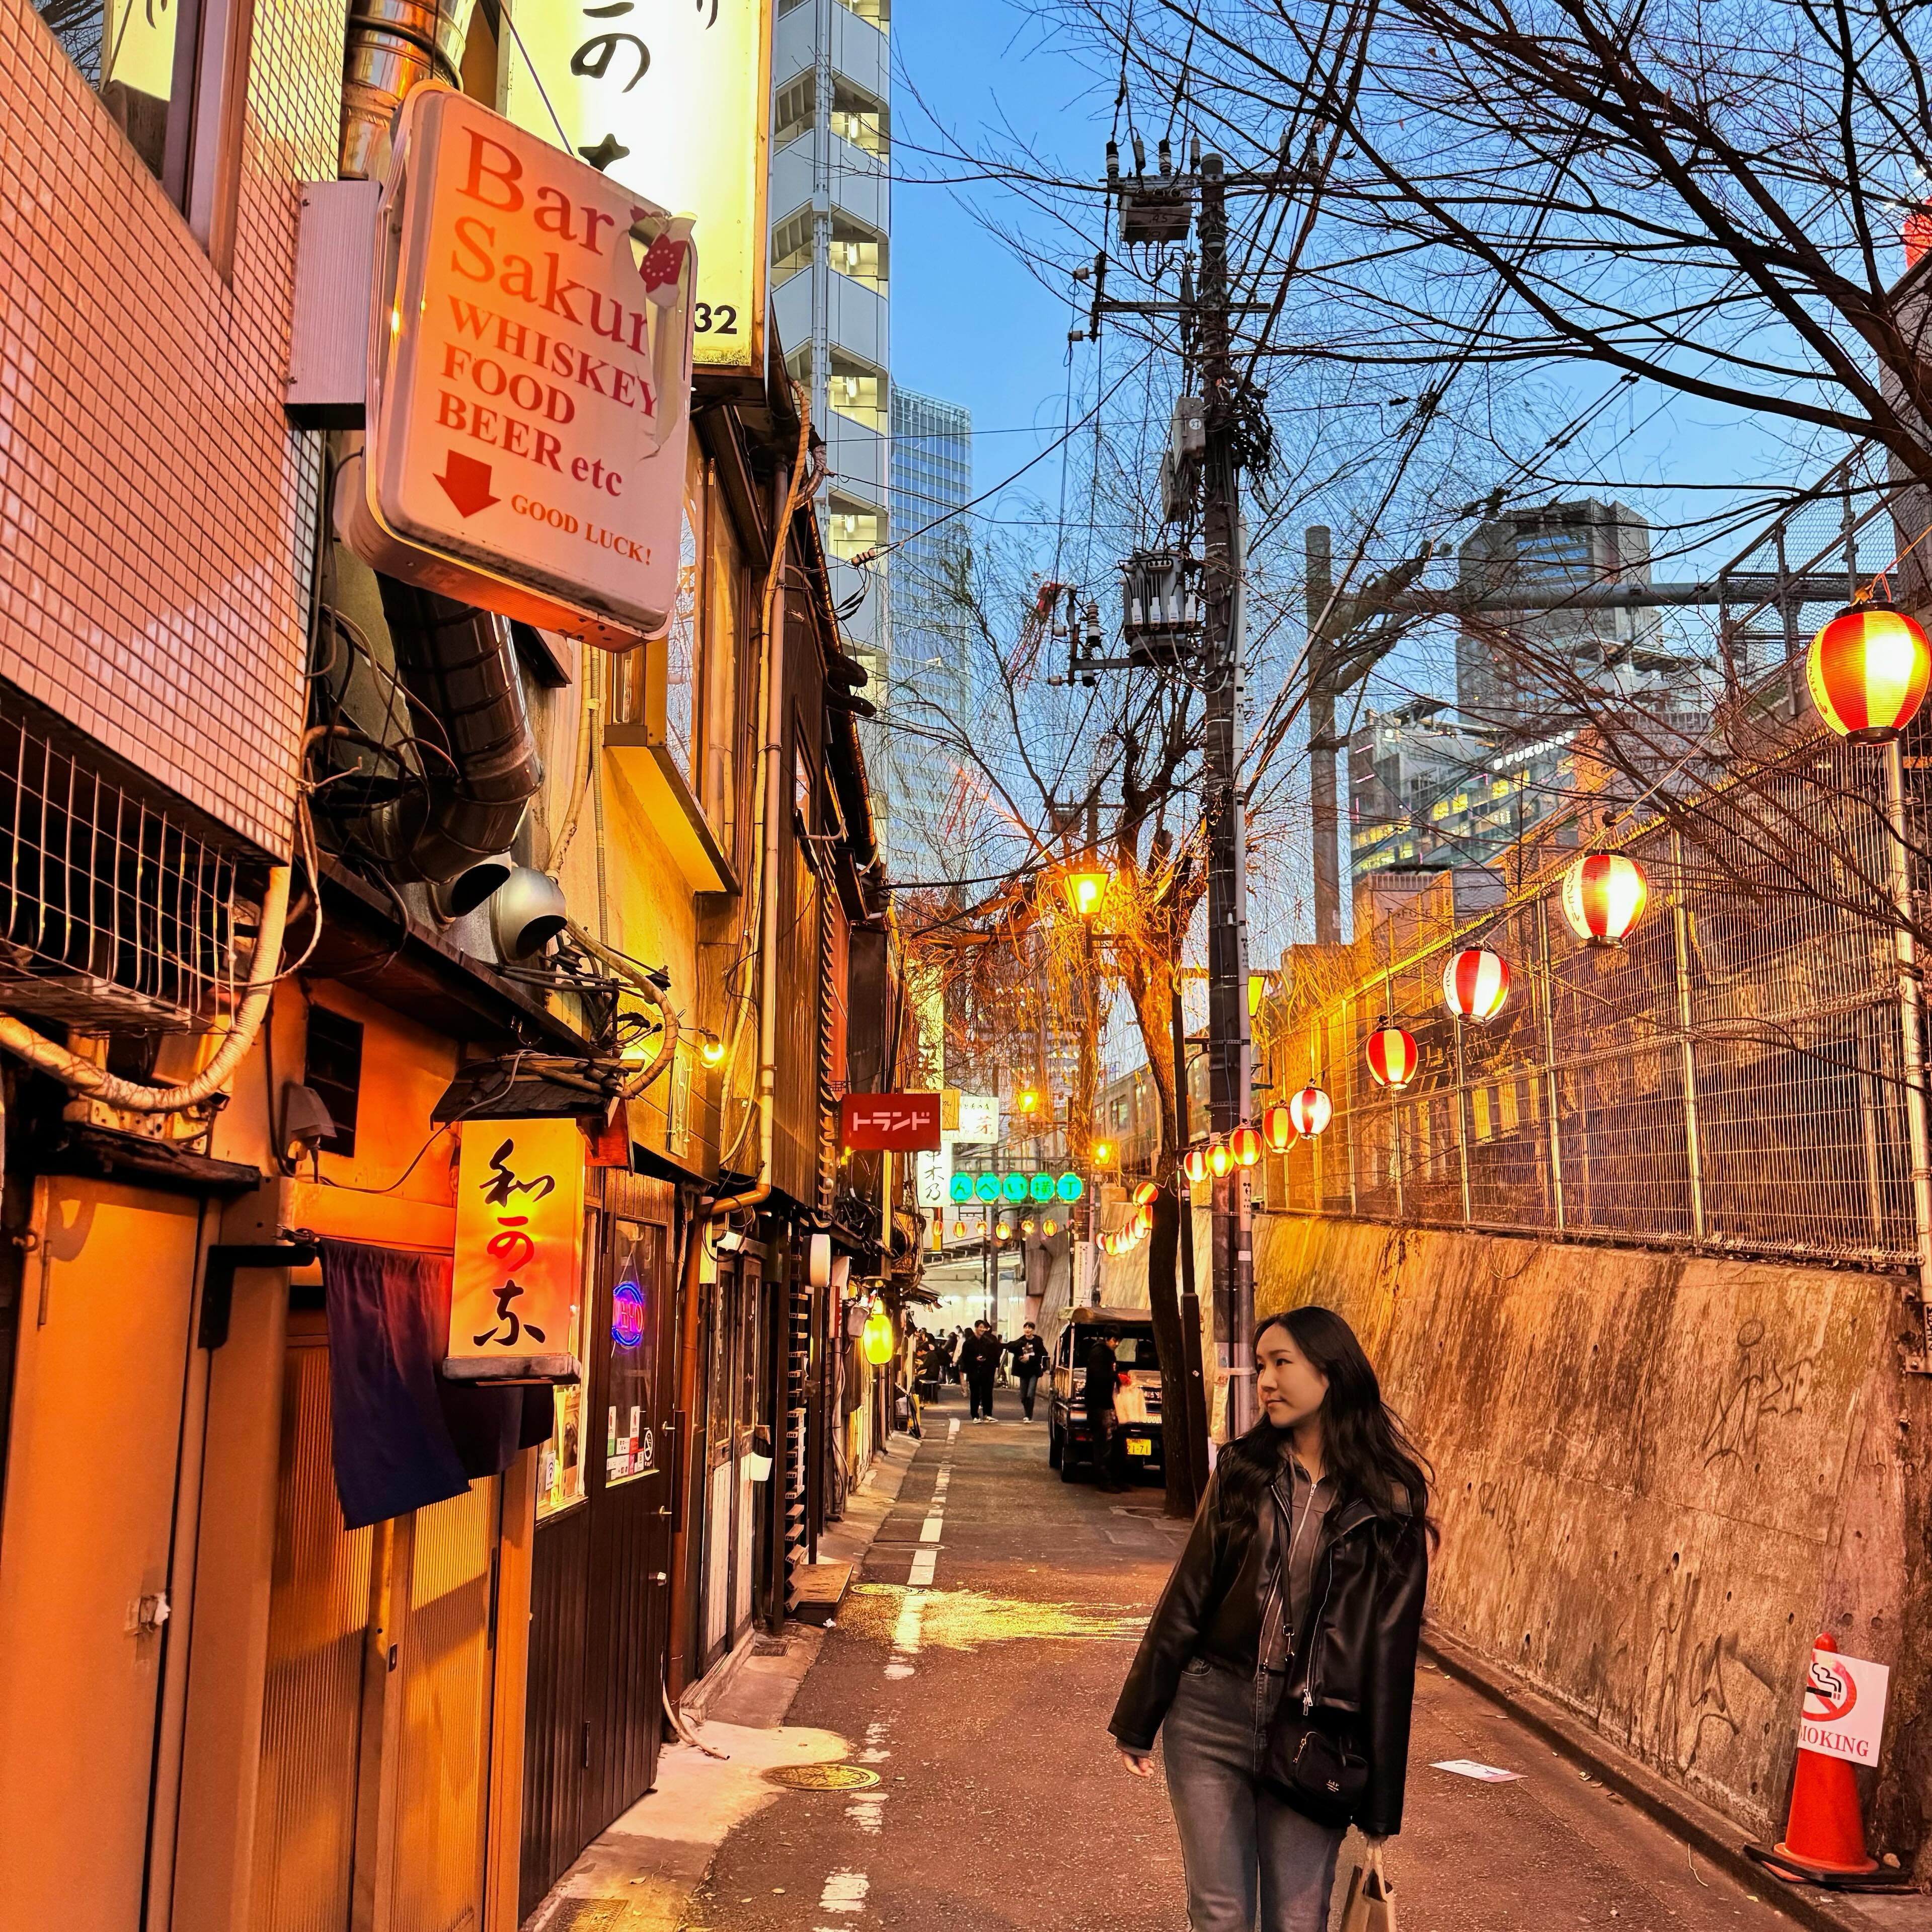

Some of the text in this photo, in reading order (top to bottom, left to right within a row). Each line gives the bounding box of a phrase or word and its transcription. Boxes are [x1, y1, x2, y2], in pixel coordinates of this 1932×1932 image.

[457, 125, 615, 257] Bar
[441, 342, 576, 426] FOOD
[448, 295, 658, 420] WHISKEY
[435, 389, 623, 498] BEER etc
[511, 494, 652, 567] GOOD LUCK!
[853, 1111, 931, 1131] トランド
